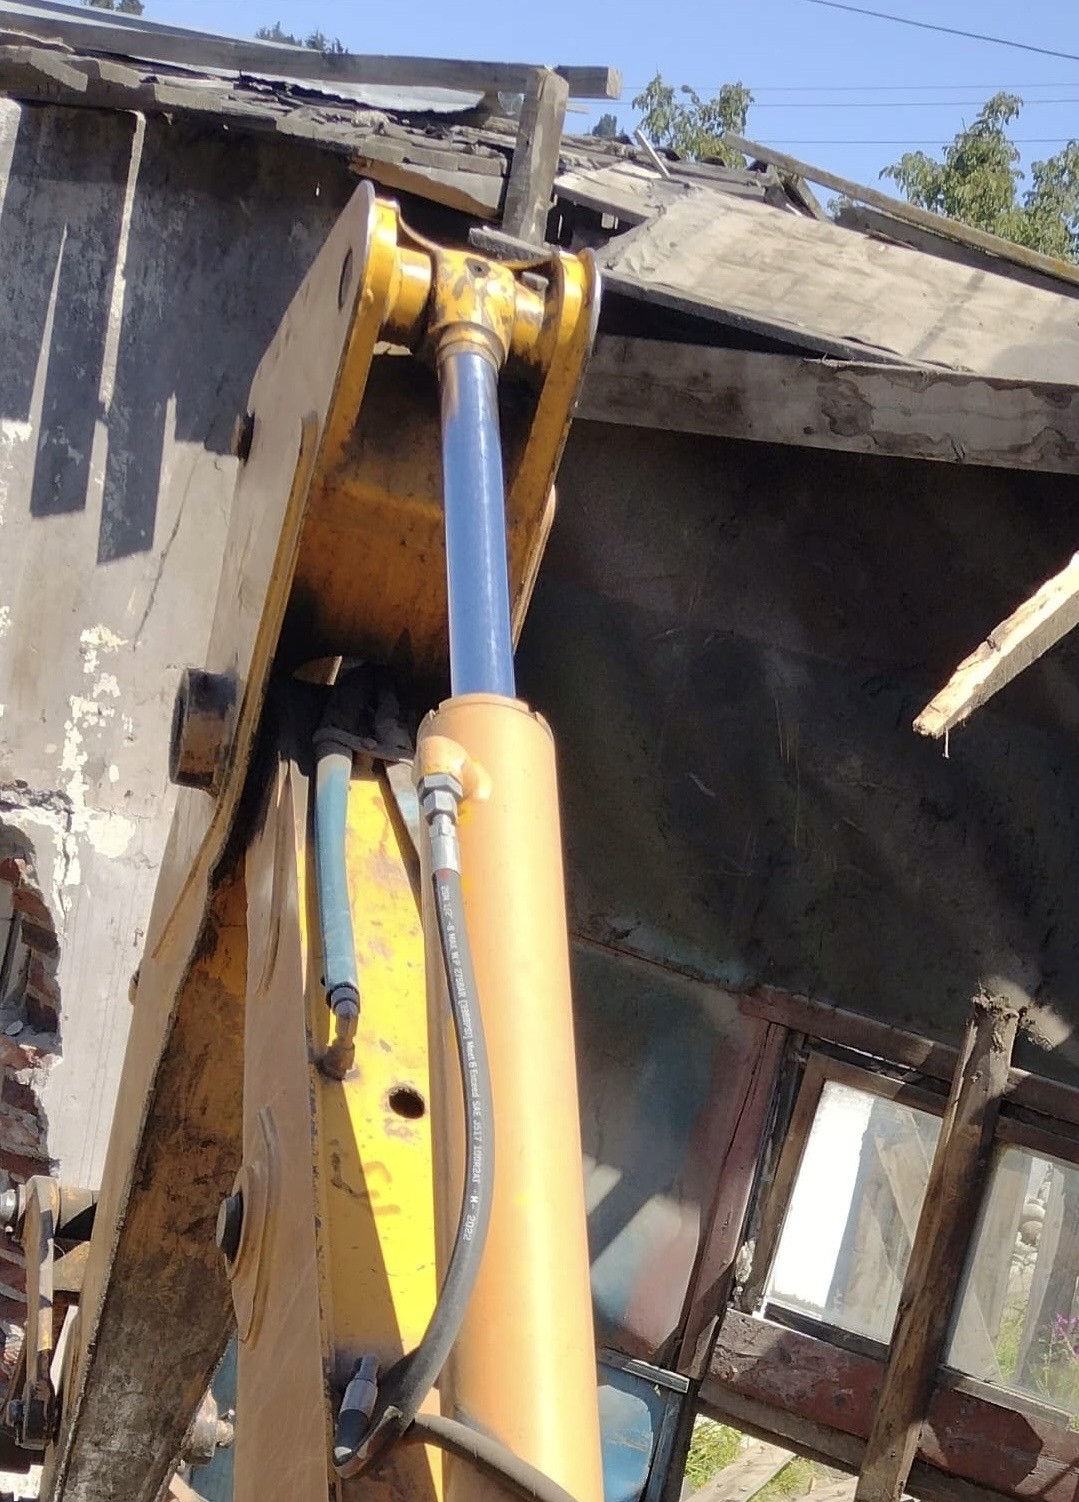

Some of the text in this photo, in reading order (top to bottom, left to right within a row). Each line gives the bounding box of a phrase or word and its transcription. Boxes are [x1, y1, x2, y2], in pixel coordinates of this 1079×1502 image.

[448, 933, 458, 949] MAX
[472, 1100, 481, 1117] SAE
[462, 1214, 477, 1241] 2022
